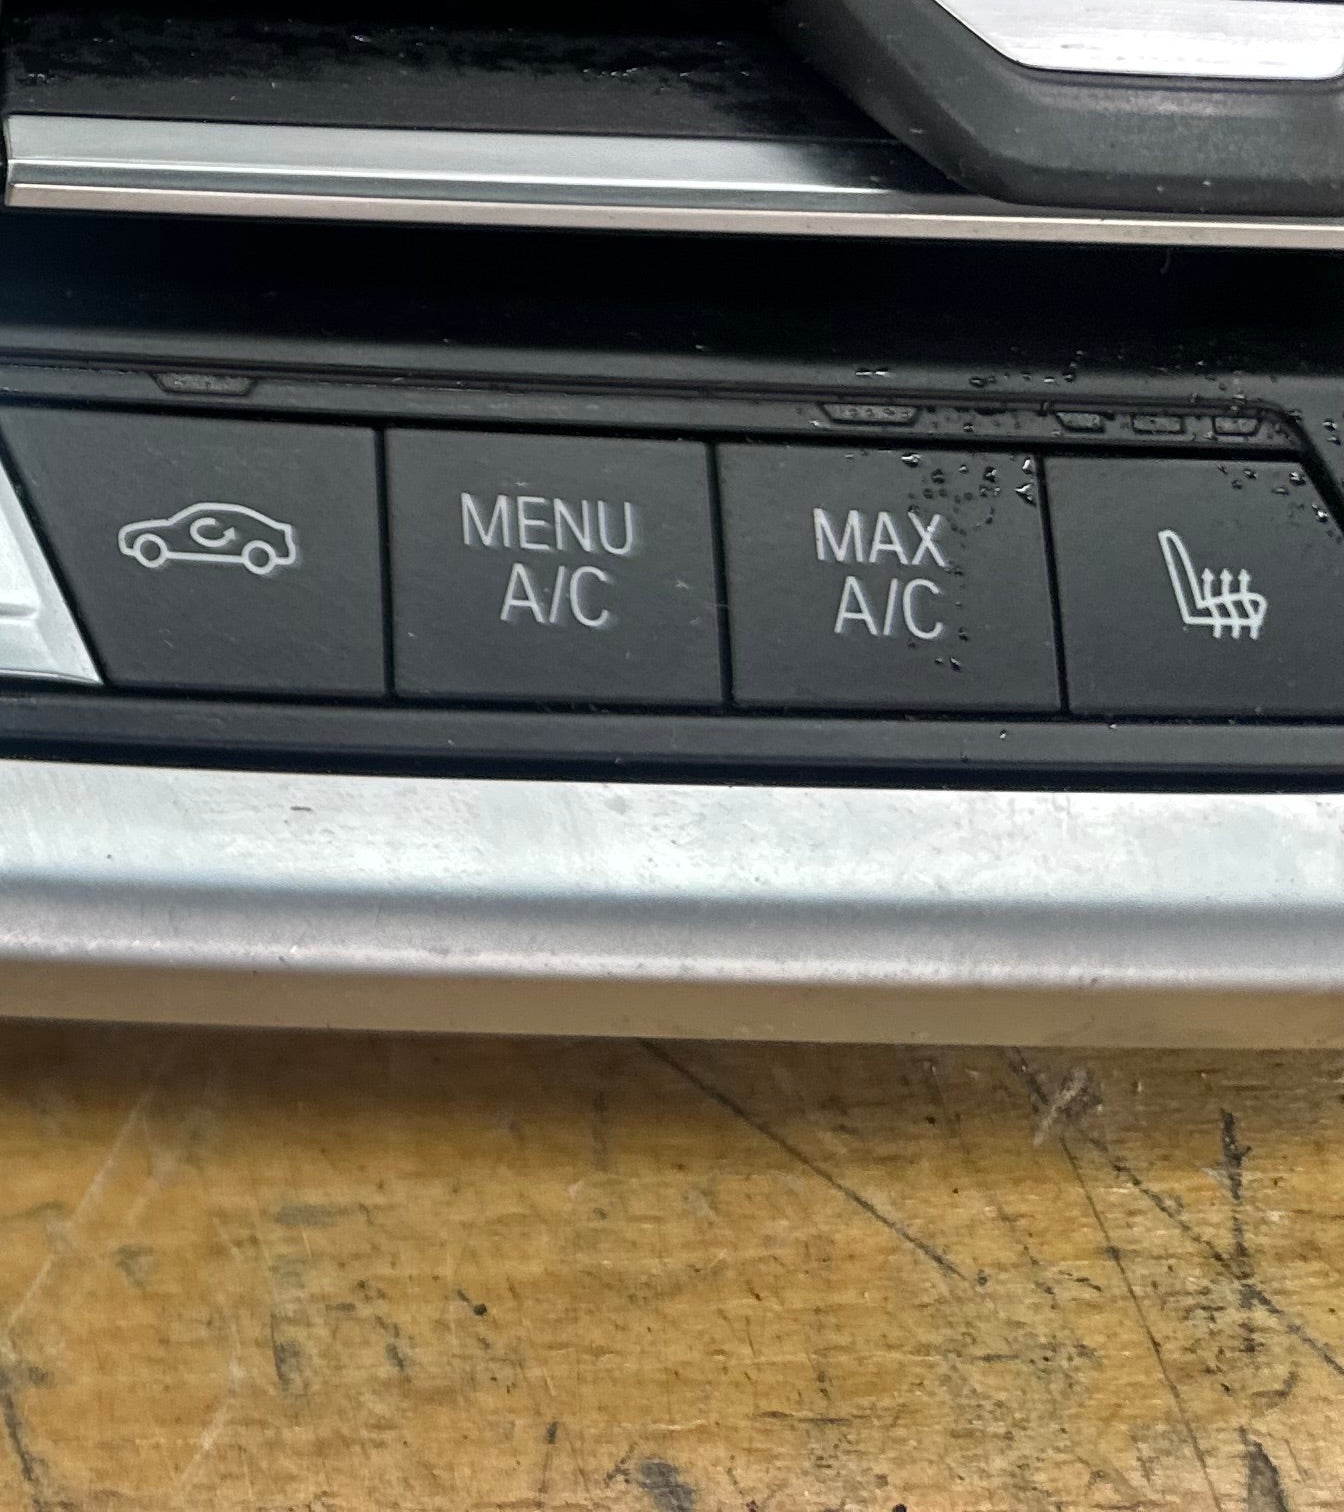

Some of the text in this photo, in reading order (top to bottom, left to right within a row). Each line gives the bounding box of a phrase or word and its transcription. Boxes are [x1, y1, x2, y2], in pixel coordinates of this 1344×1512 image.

[461, 492, 634, 556] MENU
[813, 508, 946, 567] MAX
[500, 563, 612, 629] A/C
[834, 575, 944, 641] A/C
